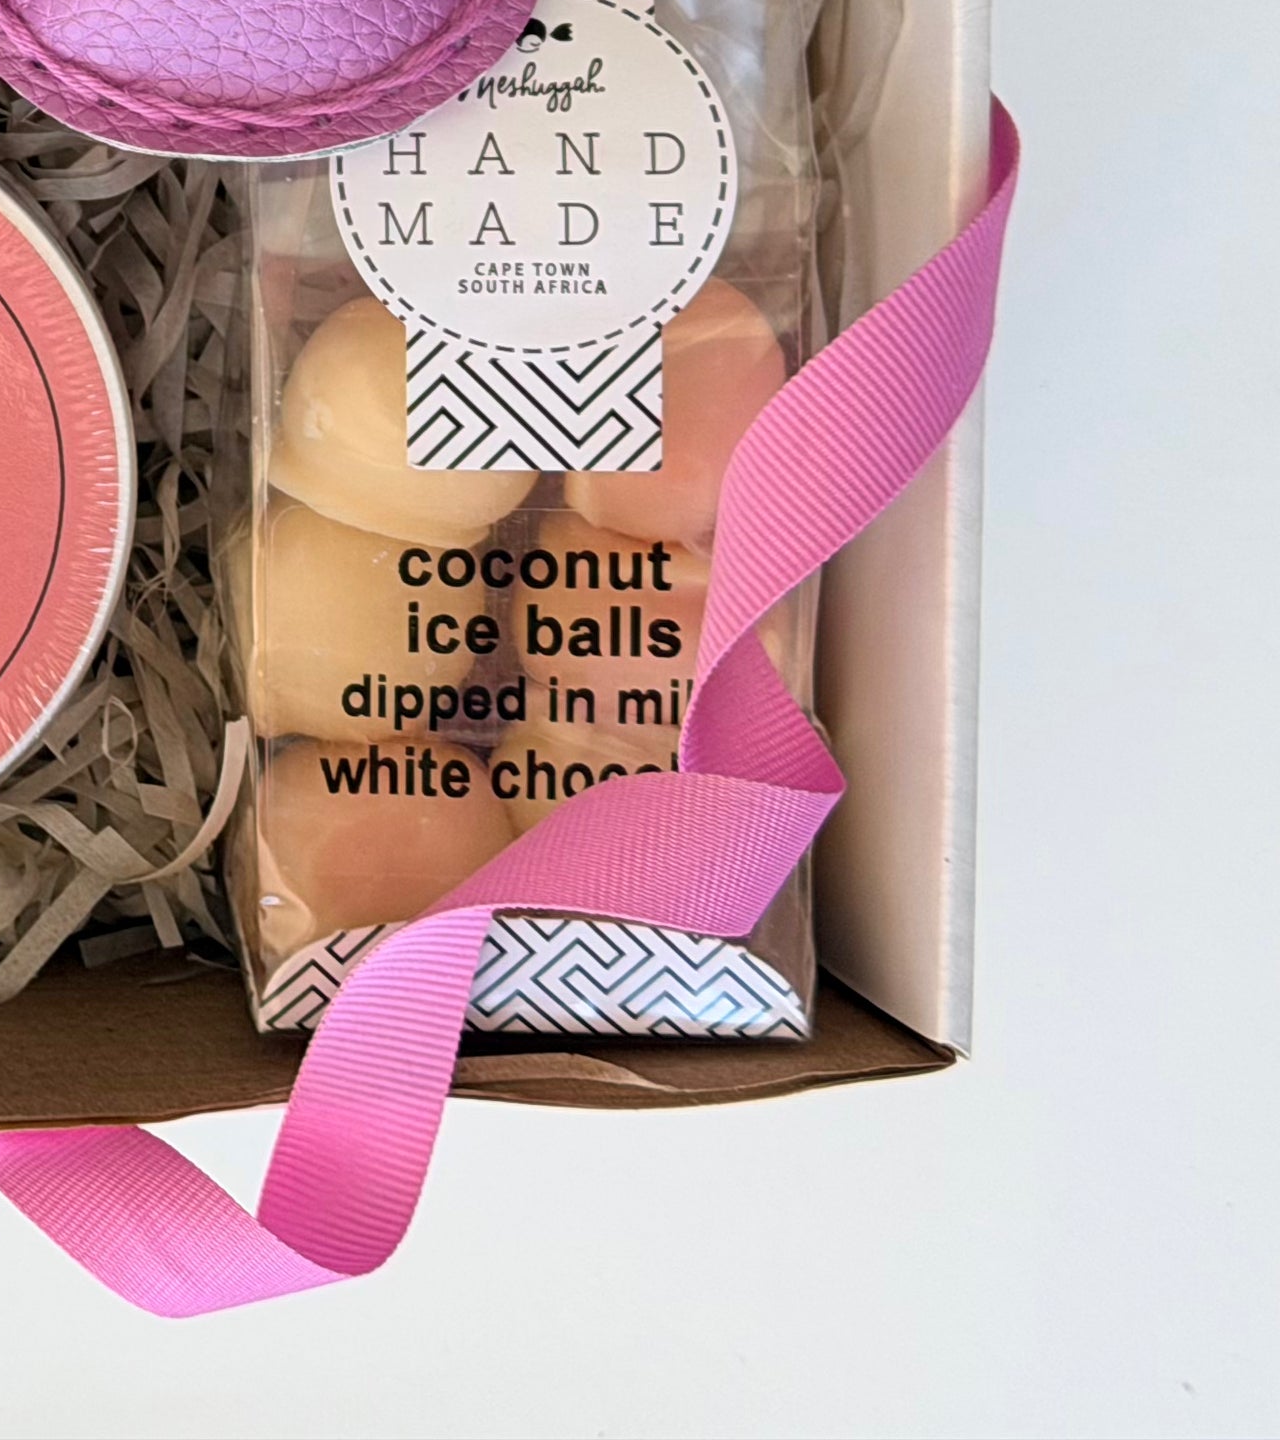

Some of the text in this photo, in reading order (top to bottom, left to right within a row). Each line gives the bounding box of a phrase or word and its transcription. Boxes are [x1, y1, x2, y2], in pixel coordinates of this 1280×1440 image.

[383, 132, 686, 175] HAND
[378, 202, 684, 246] MADE
[458, 279, 608, 295] SOUTH AFRICA
[475, 262, 590, 277] CAPE TOWN
[398, 541, 672, 591] coconut
[408, 601, 682, 658] ice balls
[341, 673, 526, 732] dipped
[549, 676, 595, 723] in
[320, 745, 471, 798] white
